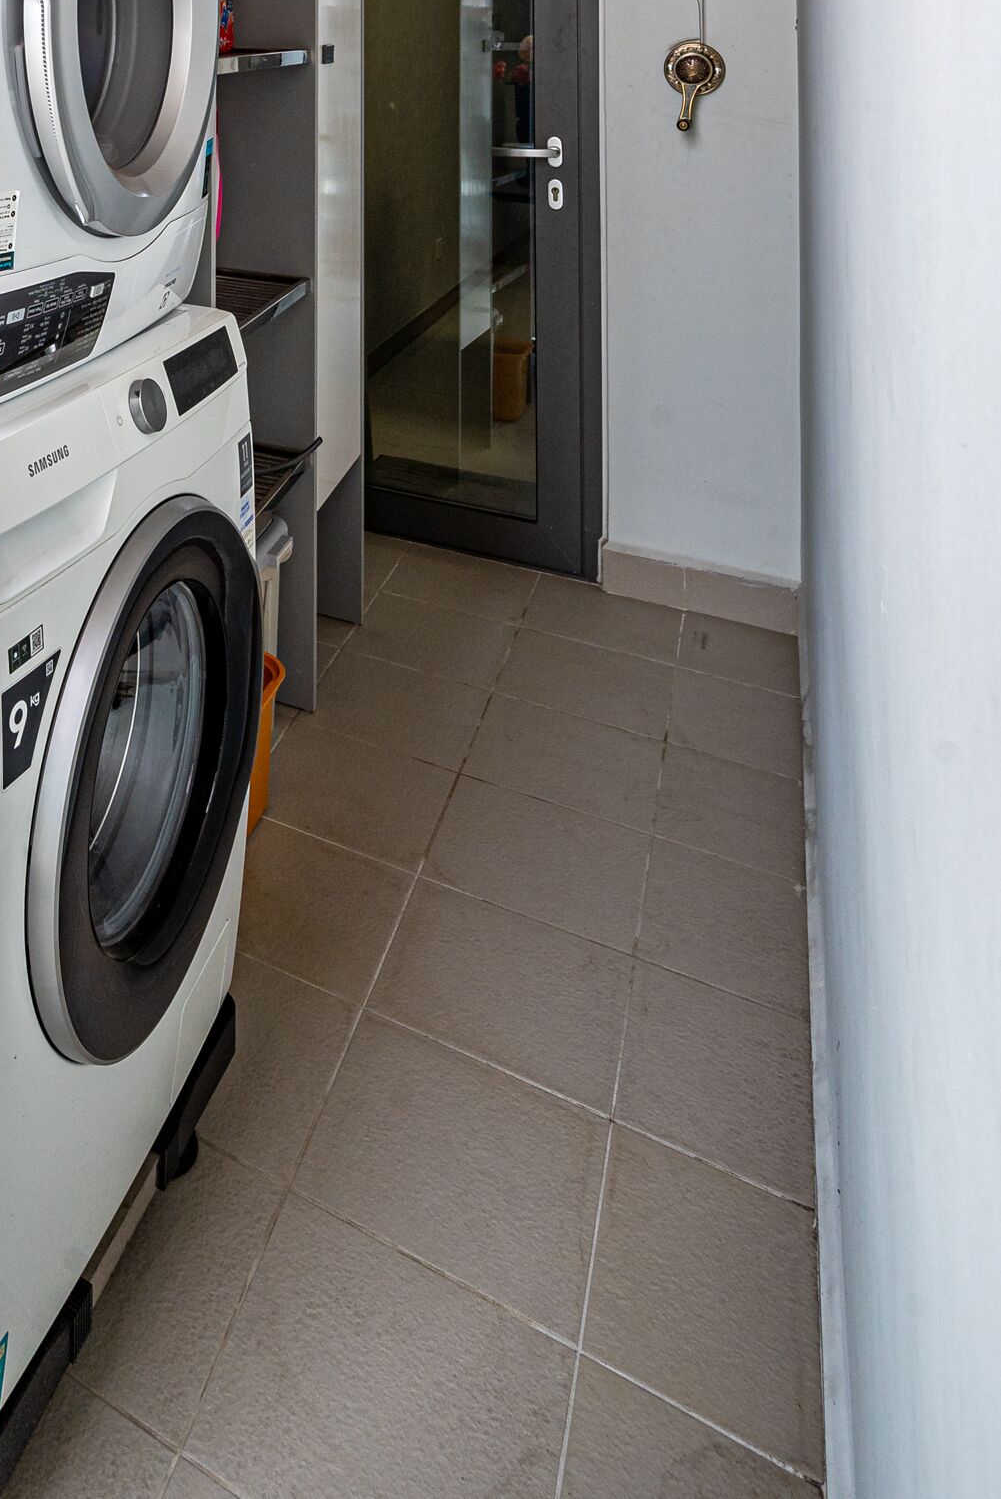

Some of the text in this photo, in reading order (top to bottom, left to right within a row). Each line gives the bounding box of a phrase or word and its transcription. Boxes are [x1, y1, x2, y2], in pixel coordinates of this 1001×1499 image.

[27, 444, 70, 478] SAMSUNG
[8, 691, 40, 750] 9 kg
